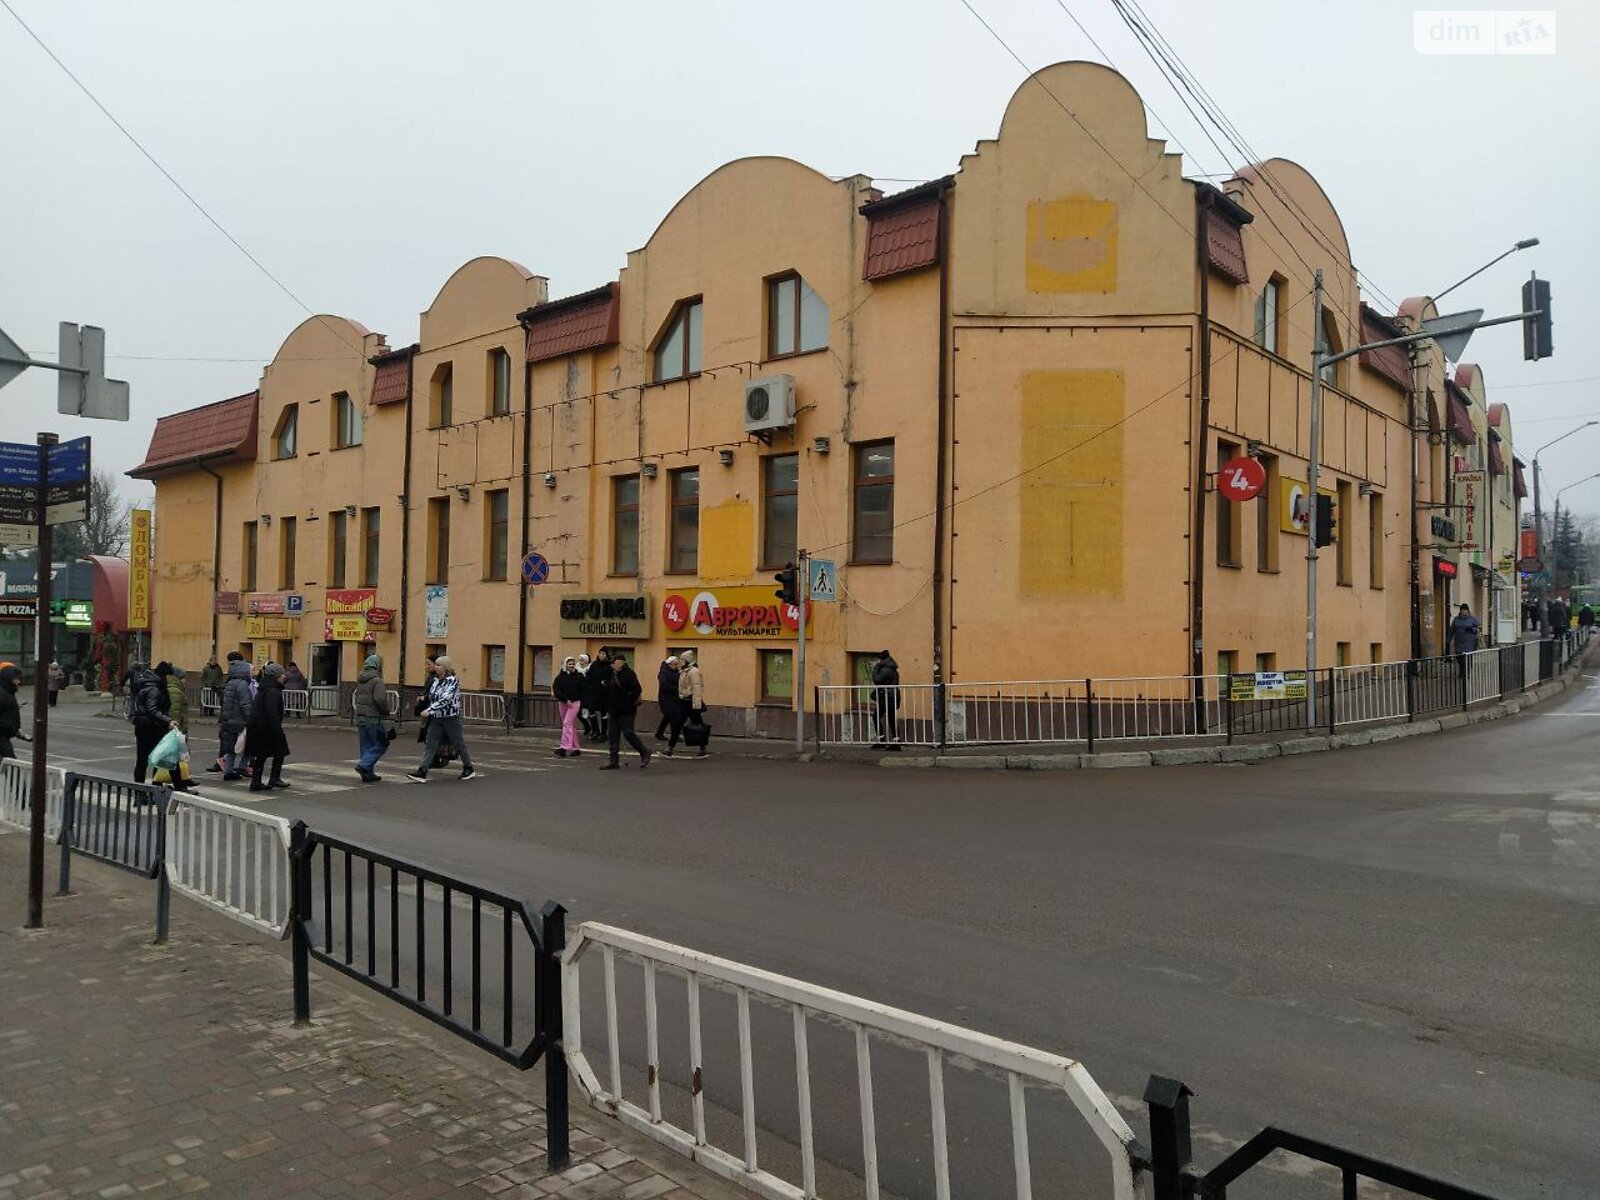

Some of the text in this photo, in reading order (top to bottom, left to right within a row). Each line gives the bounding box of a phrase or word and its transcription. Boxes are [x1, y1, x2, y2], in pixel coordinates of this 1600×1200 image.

[1231, 468, 1248, 491] 4
[8, 605, 31, 615] PIZZA
[692, 601, 782, 626] АВРОРА
[579, 622, 627, 634] СЕКОНД ХЕНД
[716, 628, 782, 636] МУЛЬТИМАРКЕТ
